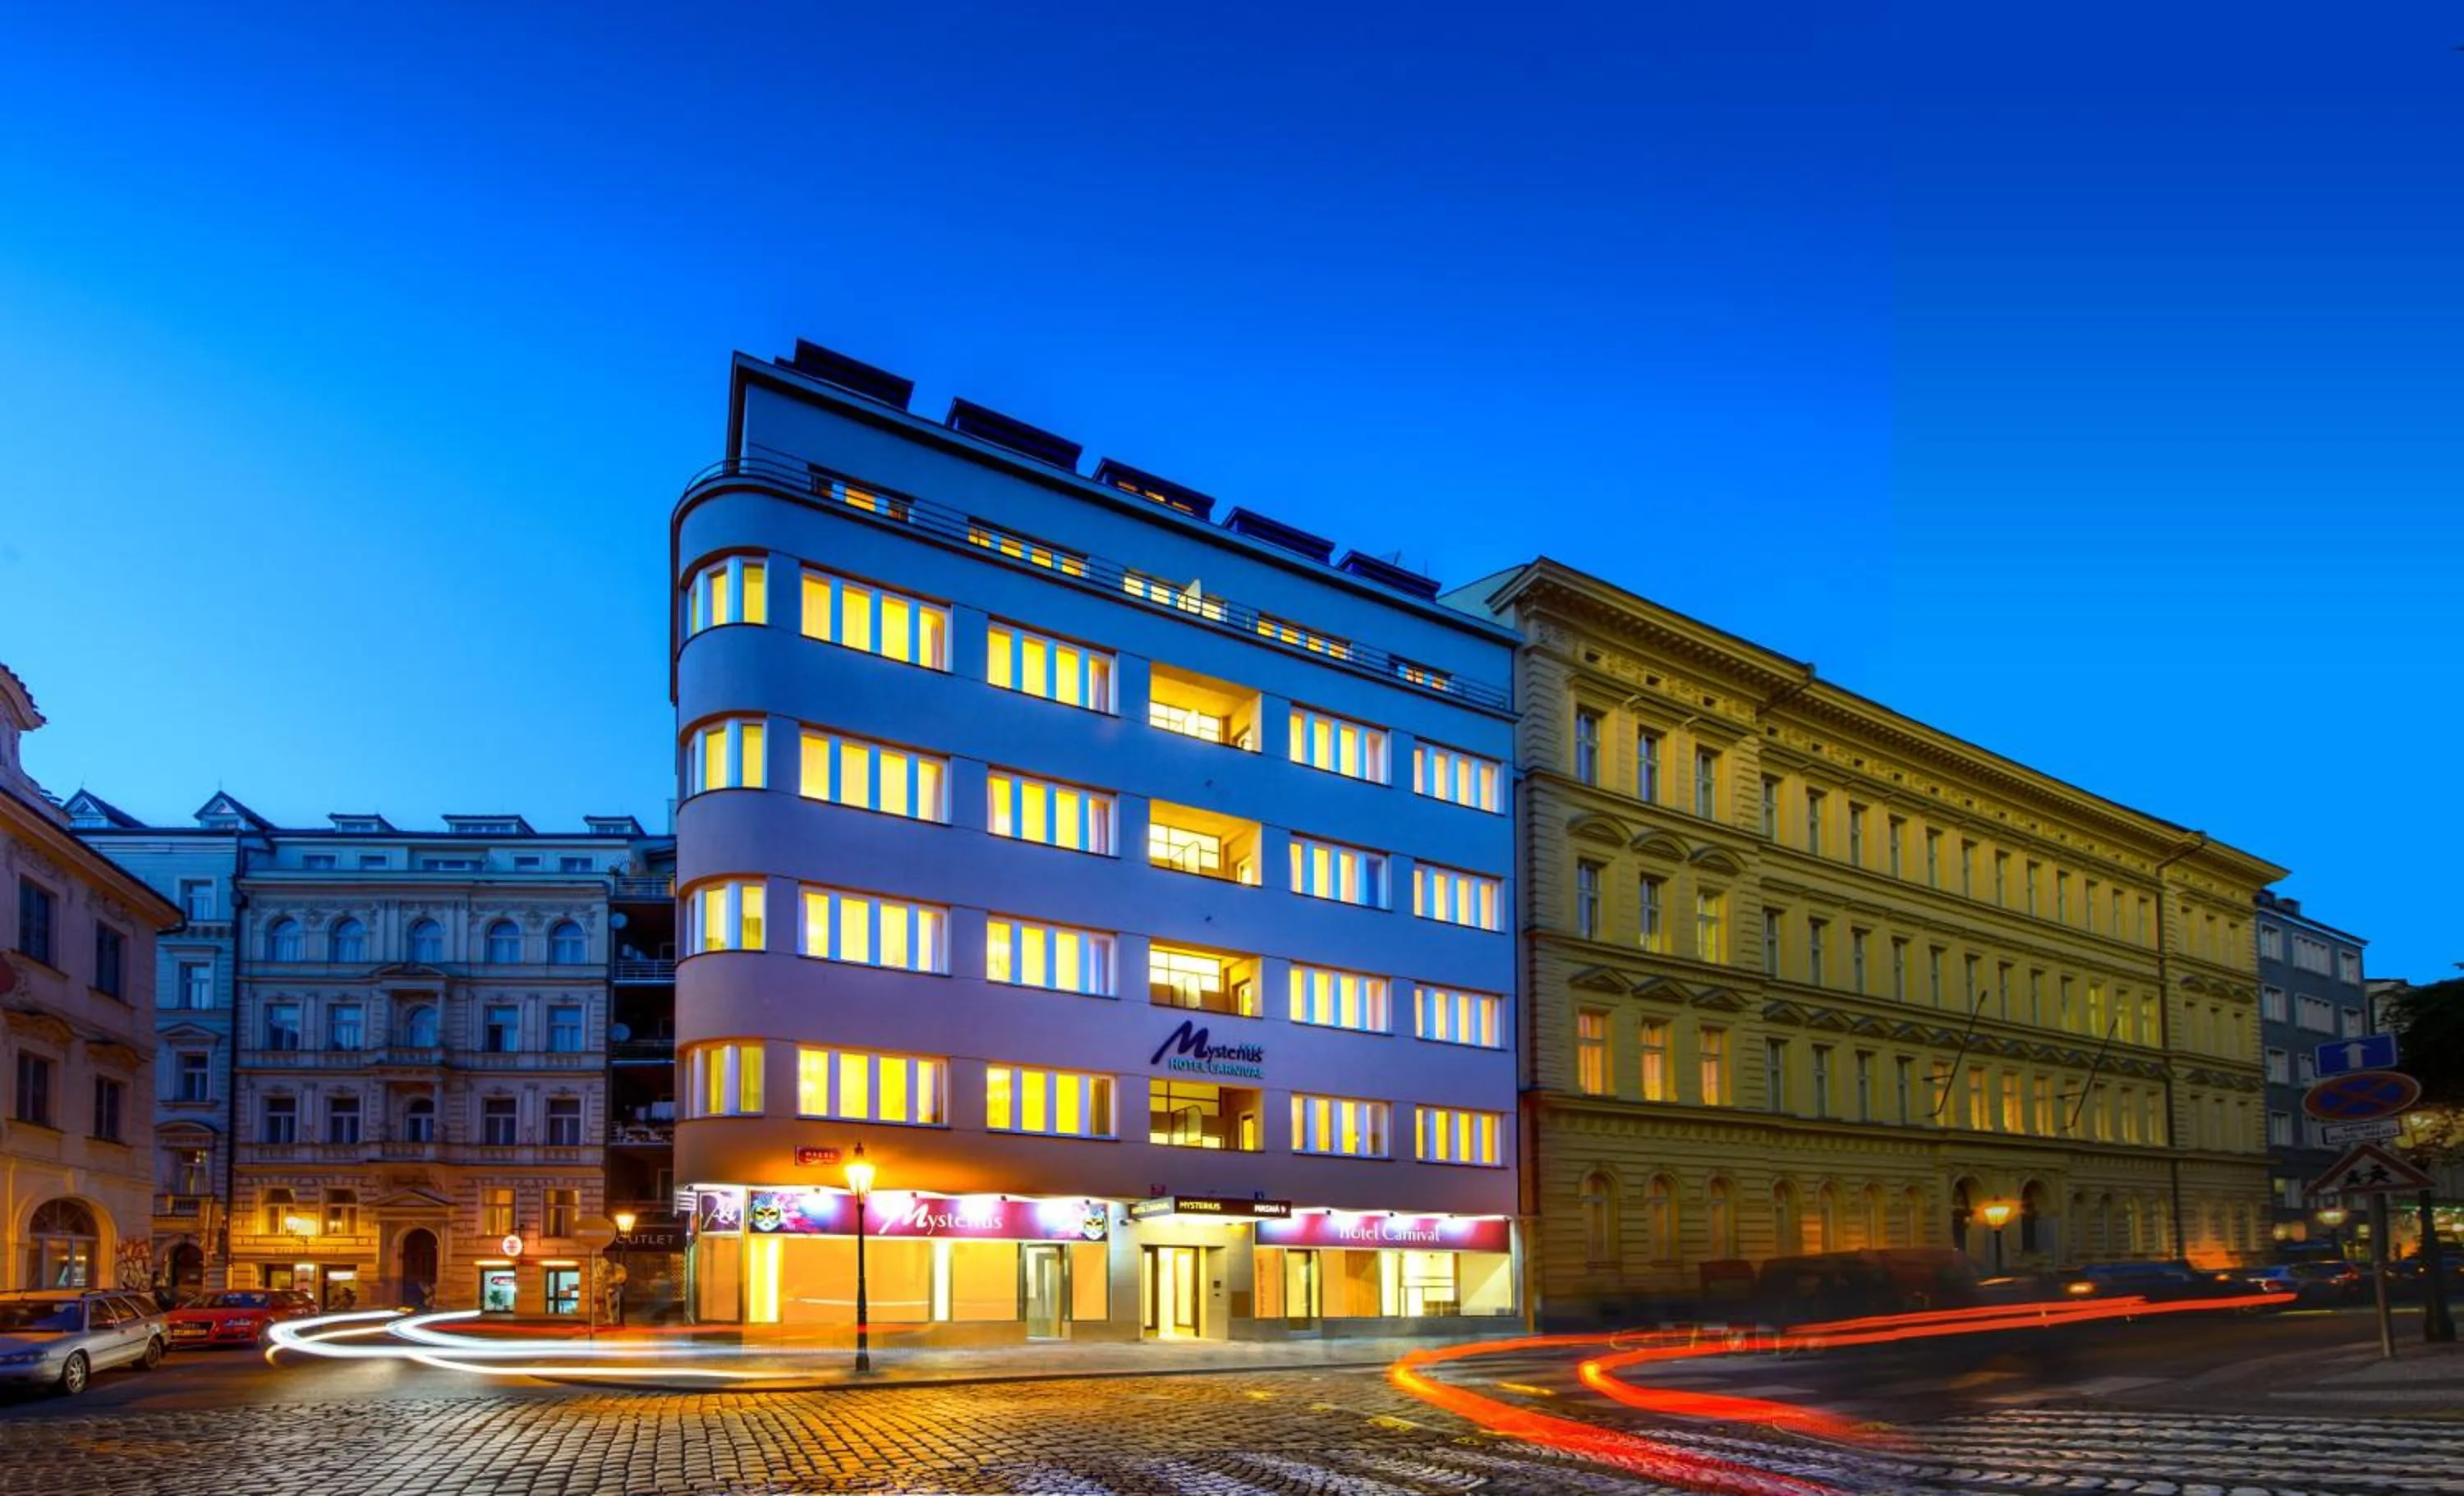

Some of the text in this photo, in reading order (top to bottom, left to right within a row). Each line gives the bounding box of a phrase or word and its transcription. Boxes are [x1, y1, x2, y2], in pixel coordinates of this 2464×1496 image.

[1151, 1020, 1263, 1063] Mysterius
[1169, 1057, 1264, 1080] HOTEL CARNIVAL
